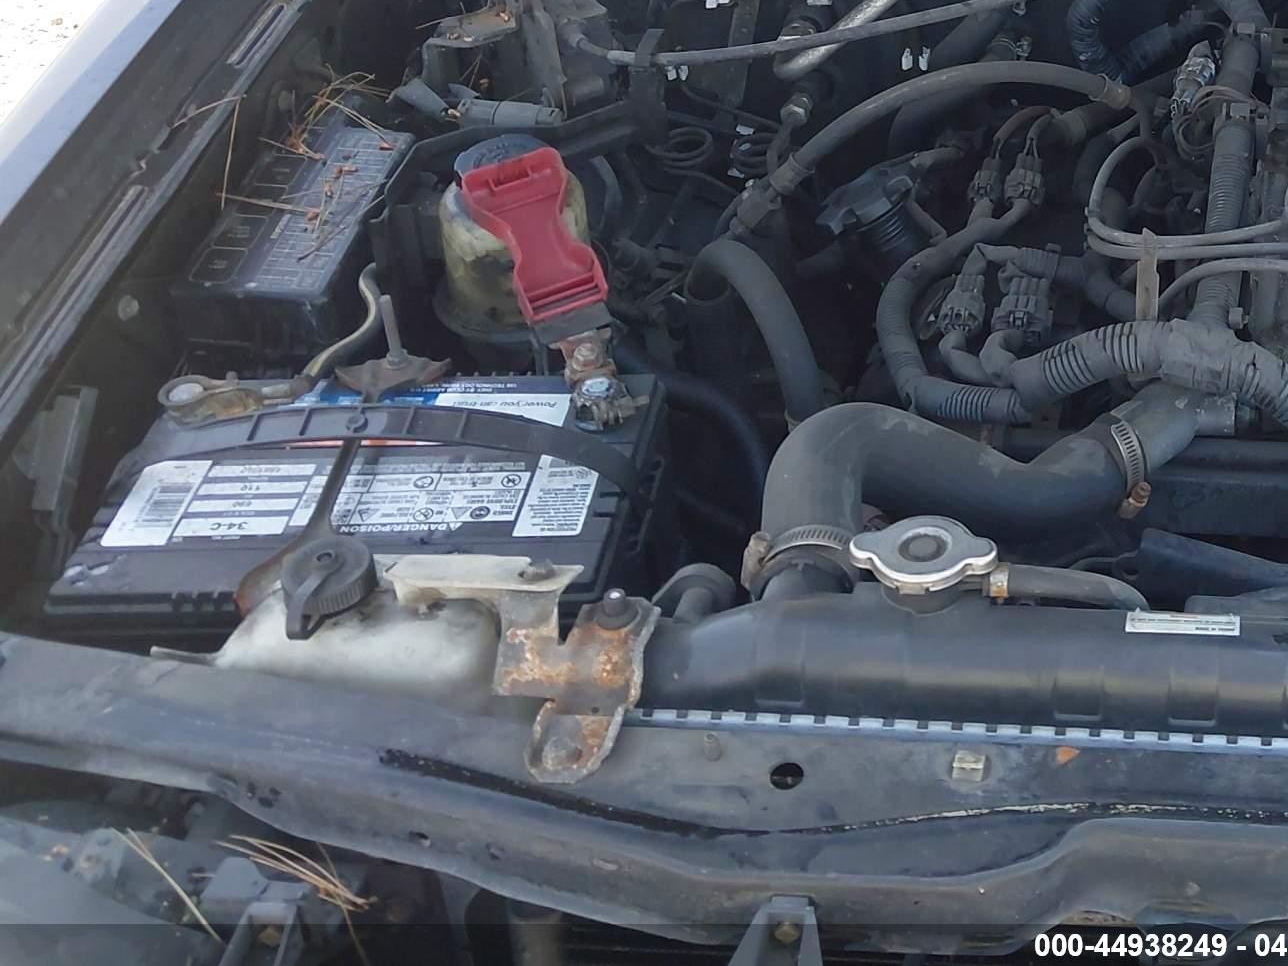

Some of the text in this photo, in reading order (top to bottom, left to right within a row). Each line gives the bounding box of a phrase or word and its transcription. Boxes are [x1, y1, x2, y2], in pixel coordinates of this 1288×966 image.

[500, 400, 520, 408] you
[209, 521, 248, 531] 34-C
[340, 522, 448, 533] DANGER/POISON
